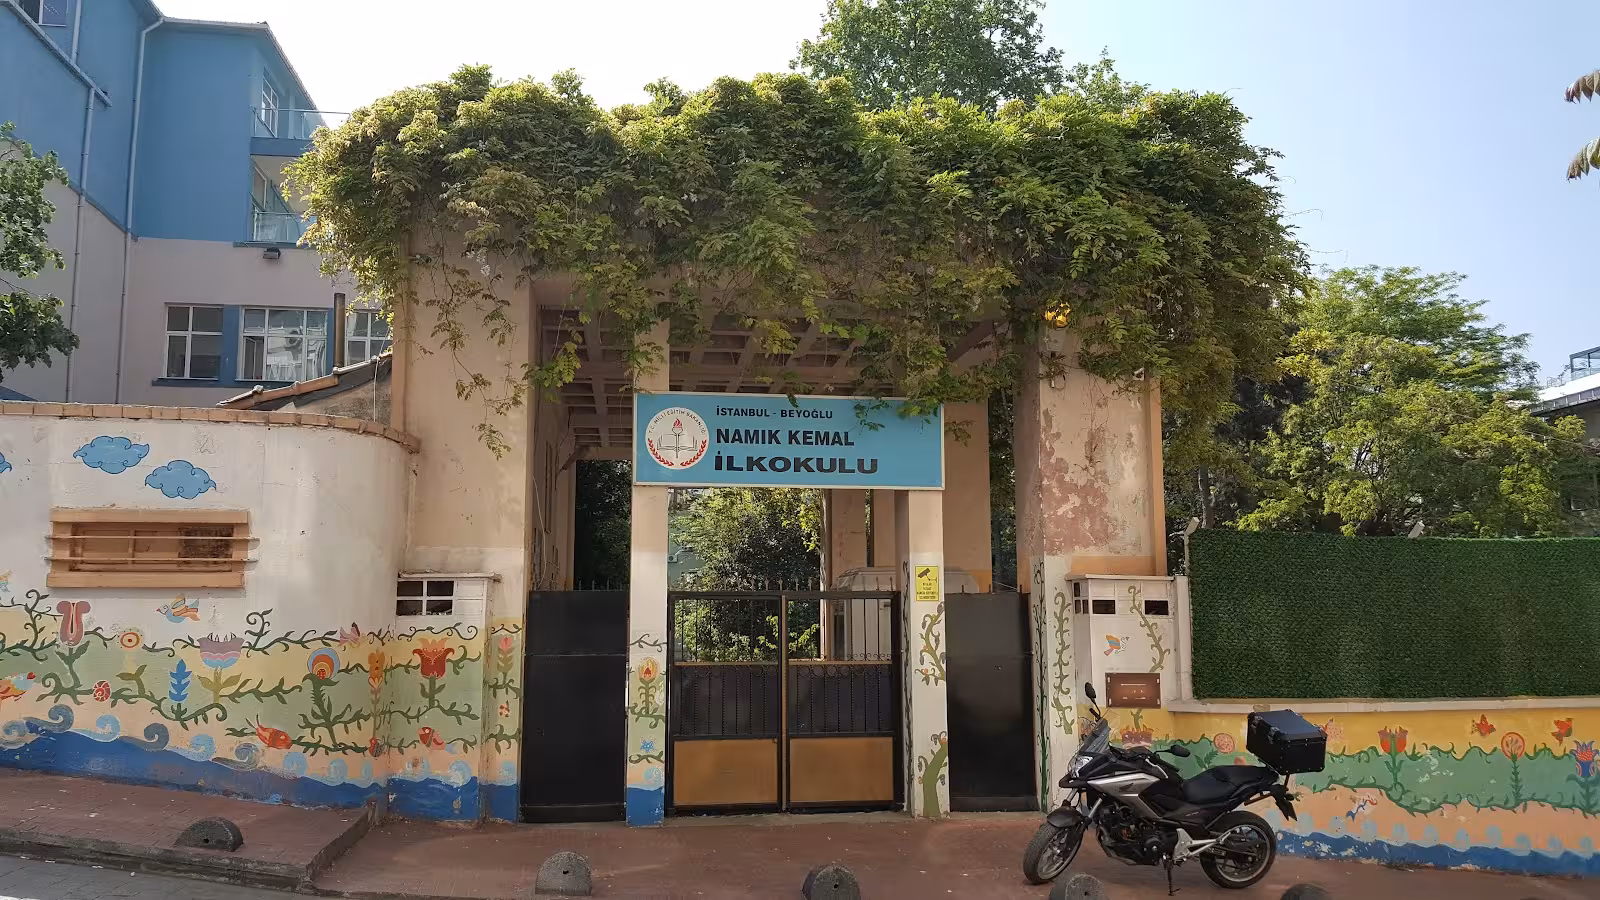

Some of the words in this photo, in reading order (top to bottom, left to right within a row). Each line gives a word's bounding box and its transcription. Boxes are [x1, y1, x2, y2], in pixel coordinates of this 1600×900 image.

[716, 405, 770, 417] İSTANBUL
[780, 408, 833, 419] BEYOĞLU
[716, 428, 781, 445] NAMIK
[788, 429, 855, 446] KEMAL
[714, 450, 878, 474] İLKOKULU
